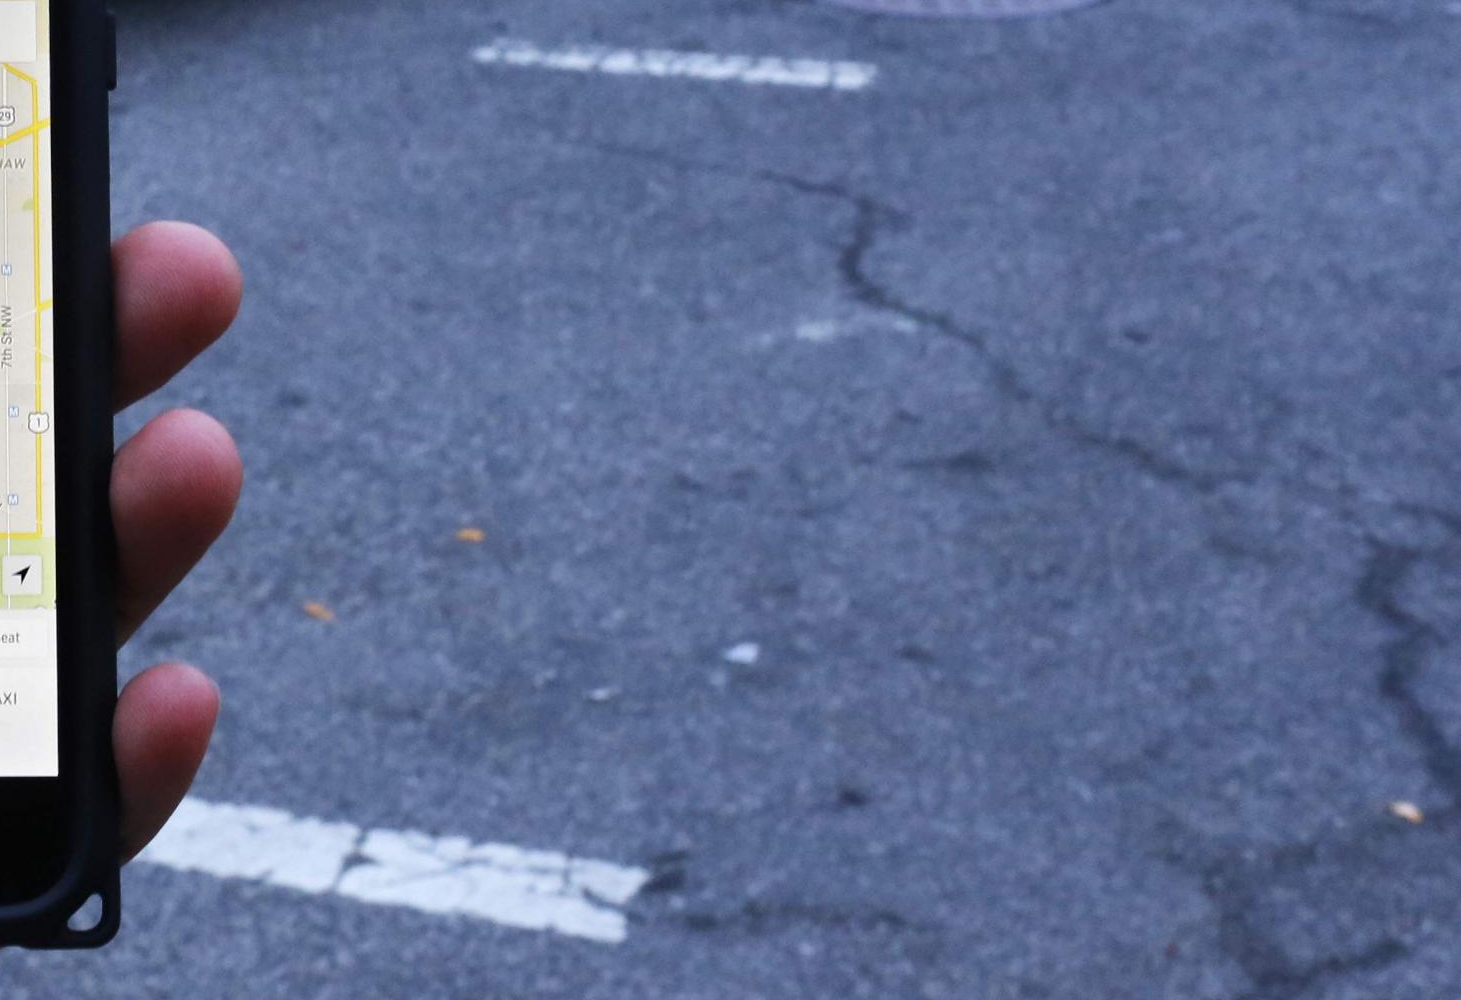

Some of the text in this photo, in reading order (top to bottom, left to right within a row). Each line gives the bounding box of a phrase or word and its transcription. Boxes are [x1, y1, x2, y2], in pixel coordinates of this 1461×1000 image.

[1, 305, 13, 369] 7th St NW
